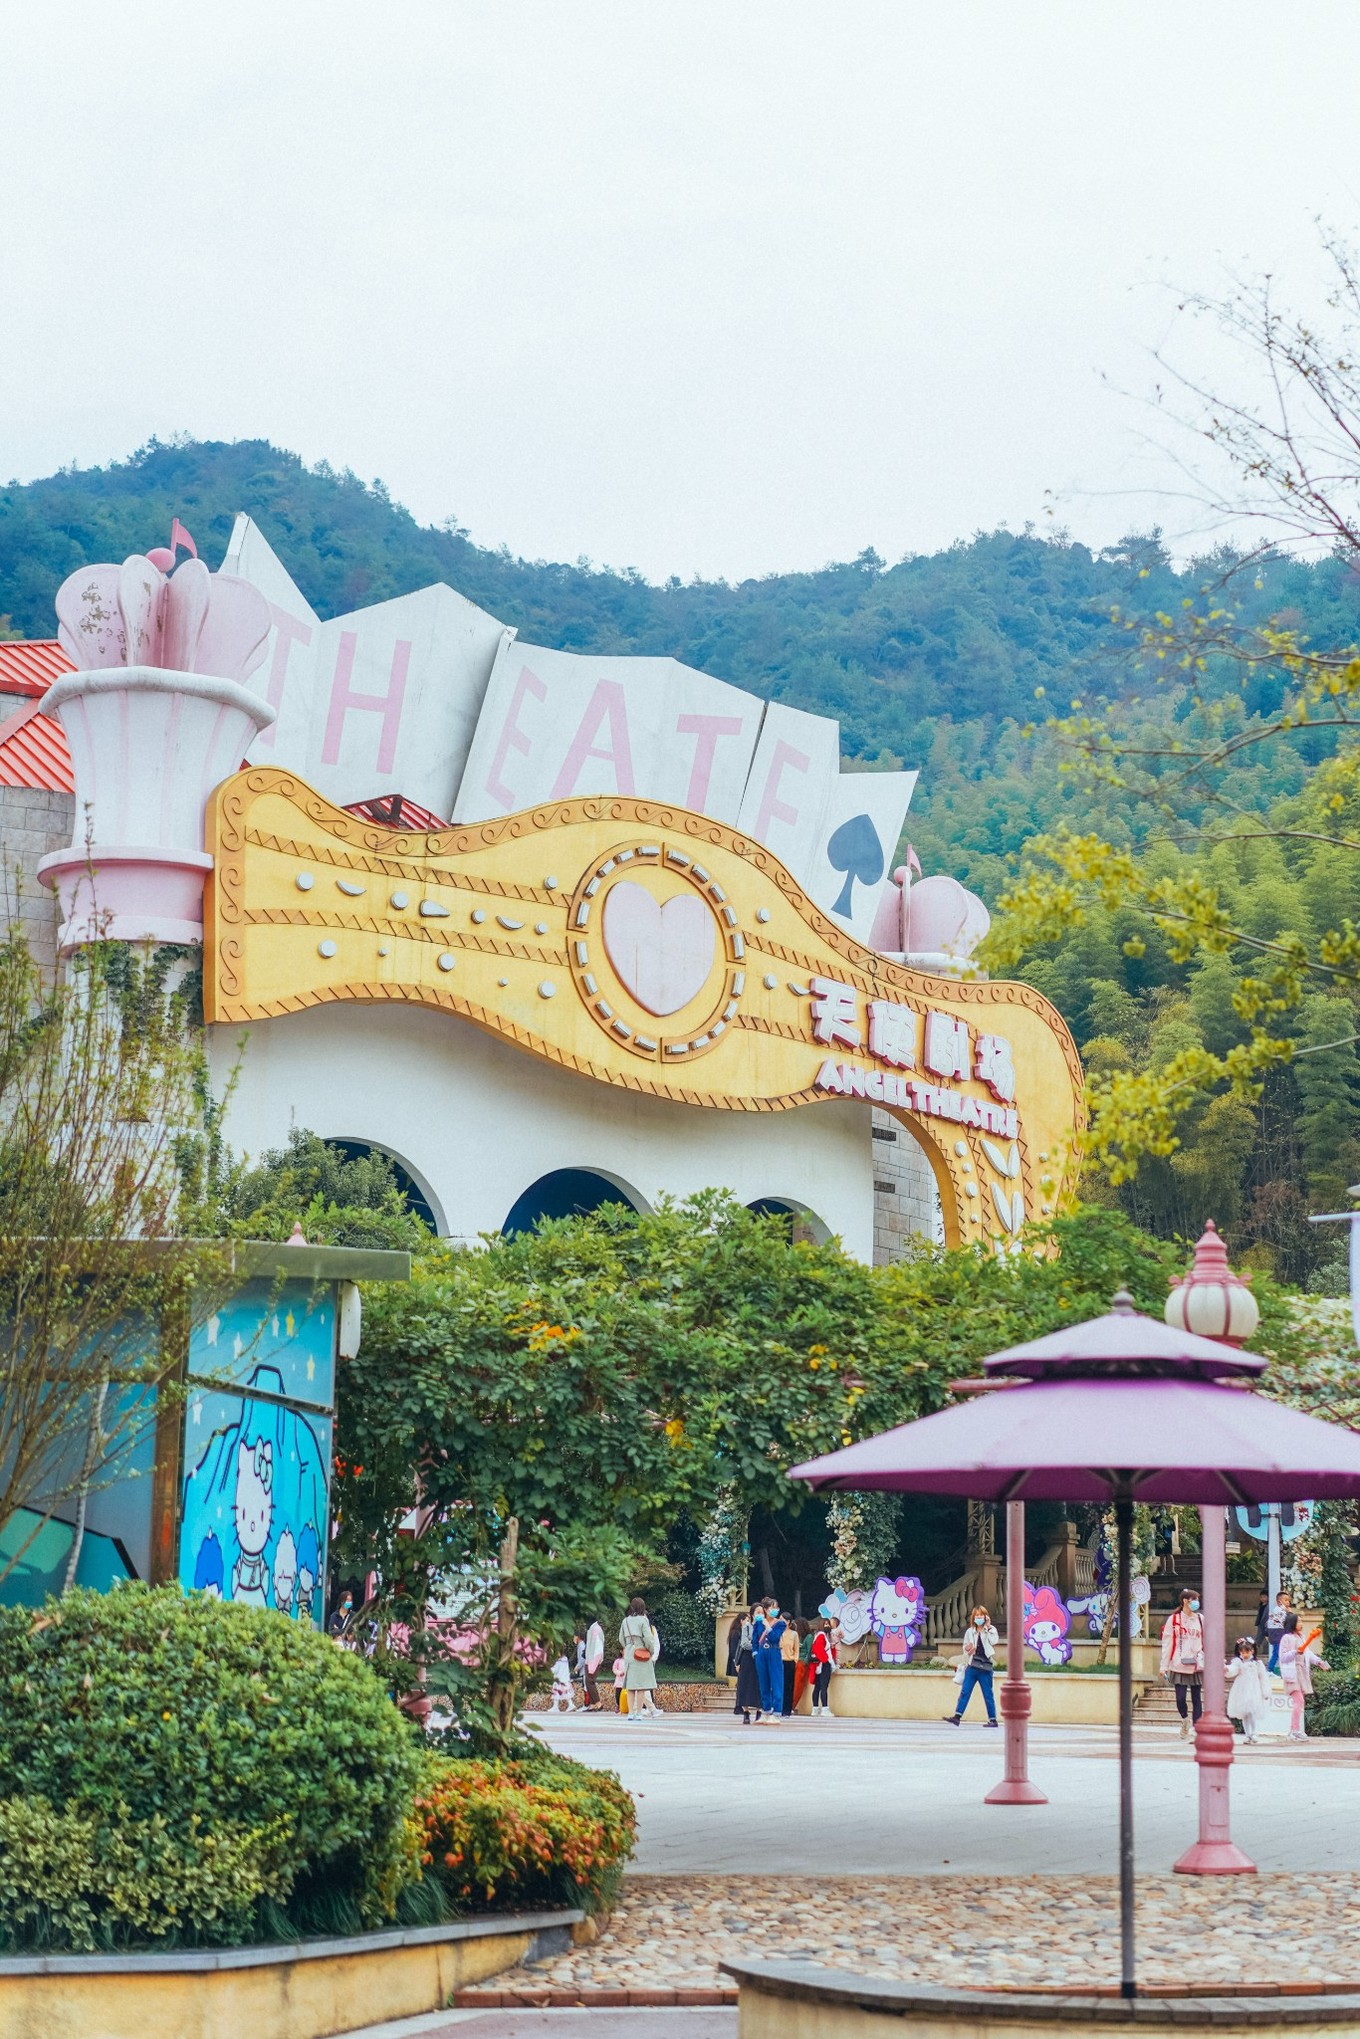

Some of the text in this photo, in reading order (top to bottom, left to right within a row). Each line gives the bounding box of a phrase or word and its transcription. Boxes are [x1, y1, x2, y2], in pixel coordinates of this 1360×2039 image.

[809, 977, 1016, 1104] 天使剧场
[815, 1059, 1018, 1140] ANGEL THEATRE
